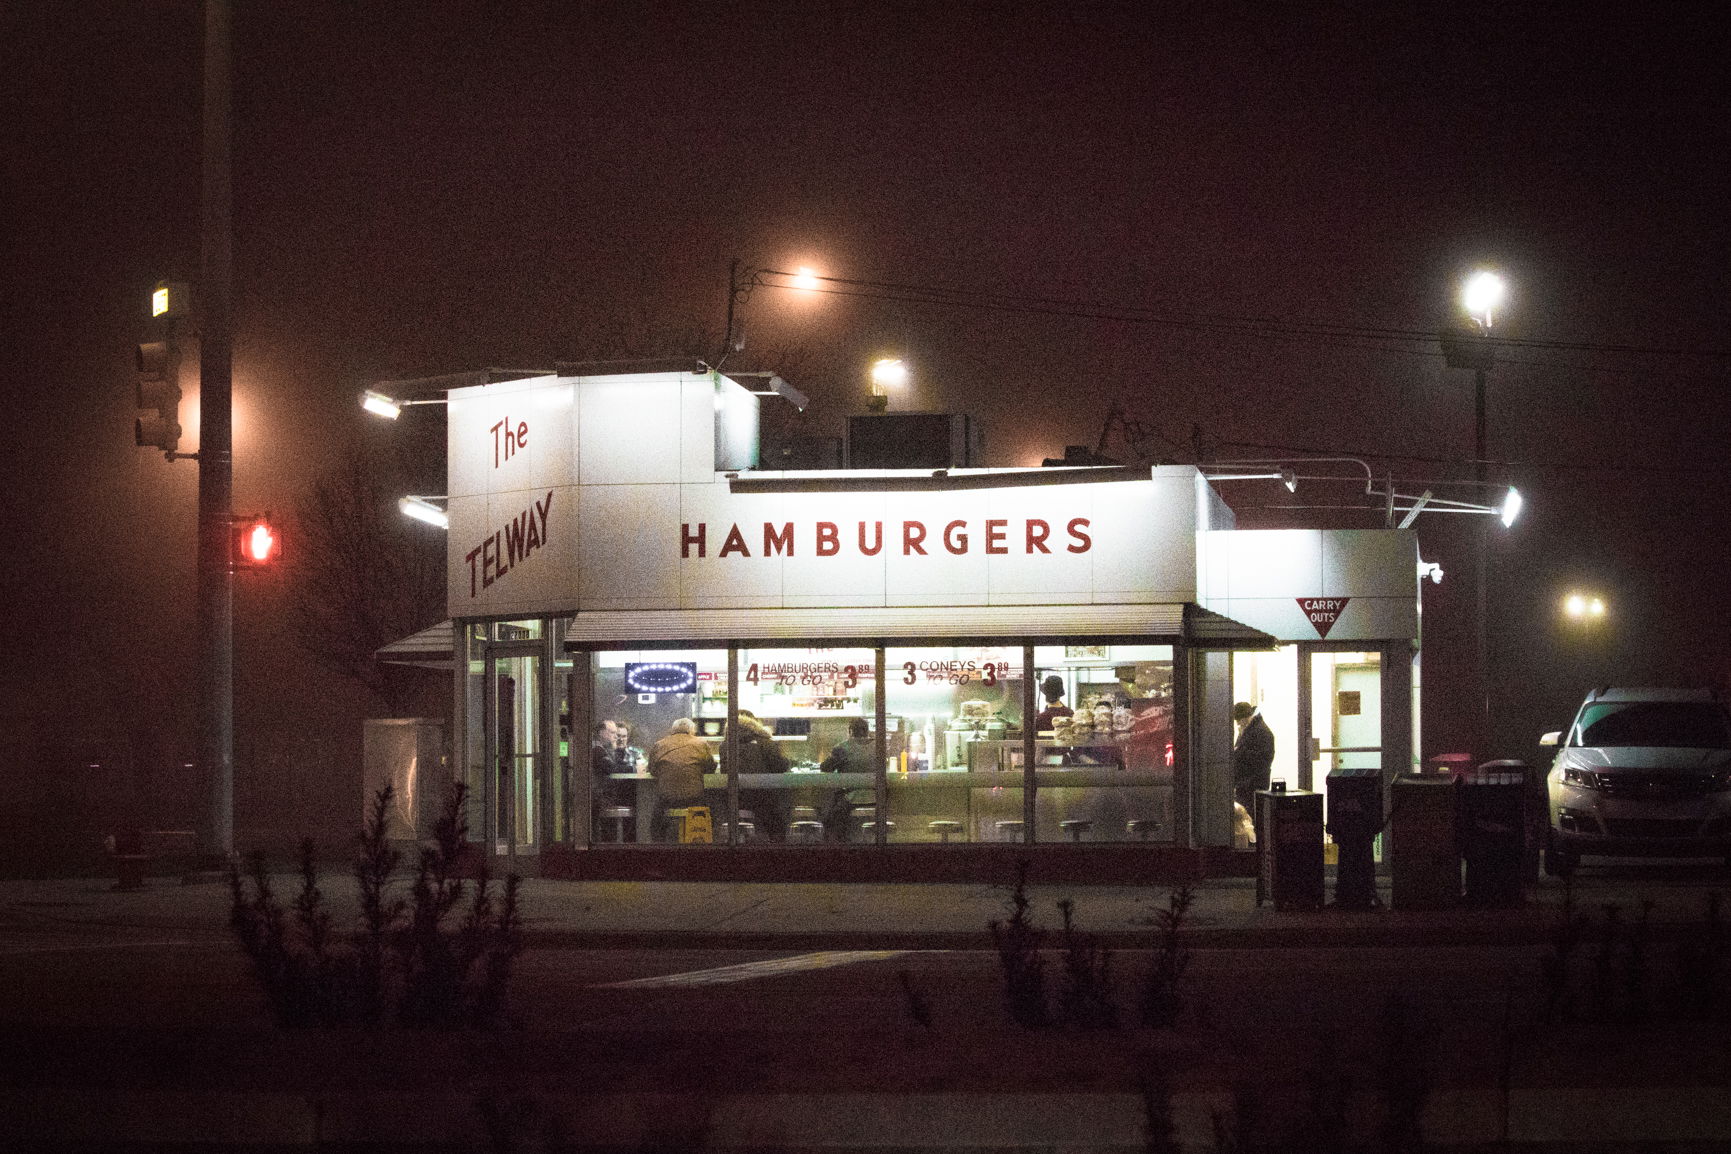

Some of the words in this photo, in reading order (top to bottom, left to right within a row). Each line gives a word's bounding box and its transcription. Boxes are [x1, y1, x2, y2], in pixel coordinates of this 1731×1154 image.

[490, 416, 529, 469] The
[465, 489, 553, 598] TELWAY
[681, 517, 1092, 558] HAMBURGERS
[1304, 600, 1342, 610] CARRY
[1310, 612, 1335, 623] OUTS
[746, 663, 760, 687] 4
[762, 662, 839, 674] HAMBURGERS
[843, 665, 858, 689] 3
[858, 664, 871, 674] 89
[775, 674, 797, 686] TO
[801, 674, 823, 686] GO
[903, 661, 917, 686] 3
[919, 660, 976, 672] CONEYS
[982, 662, 997, 687] 3
[948, 673, 970, 686] GO
